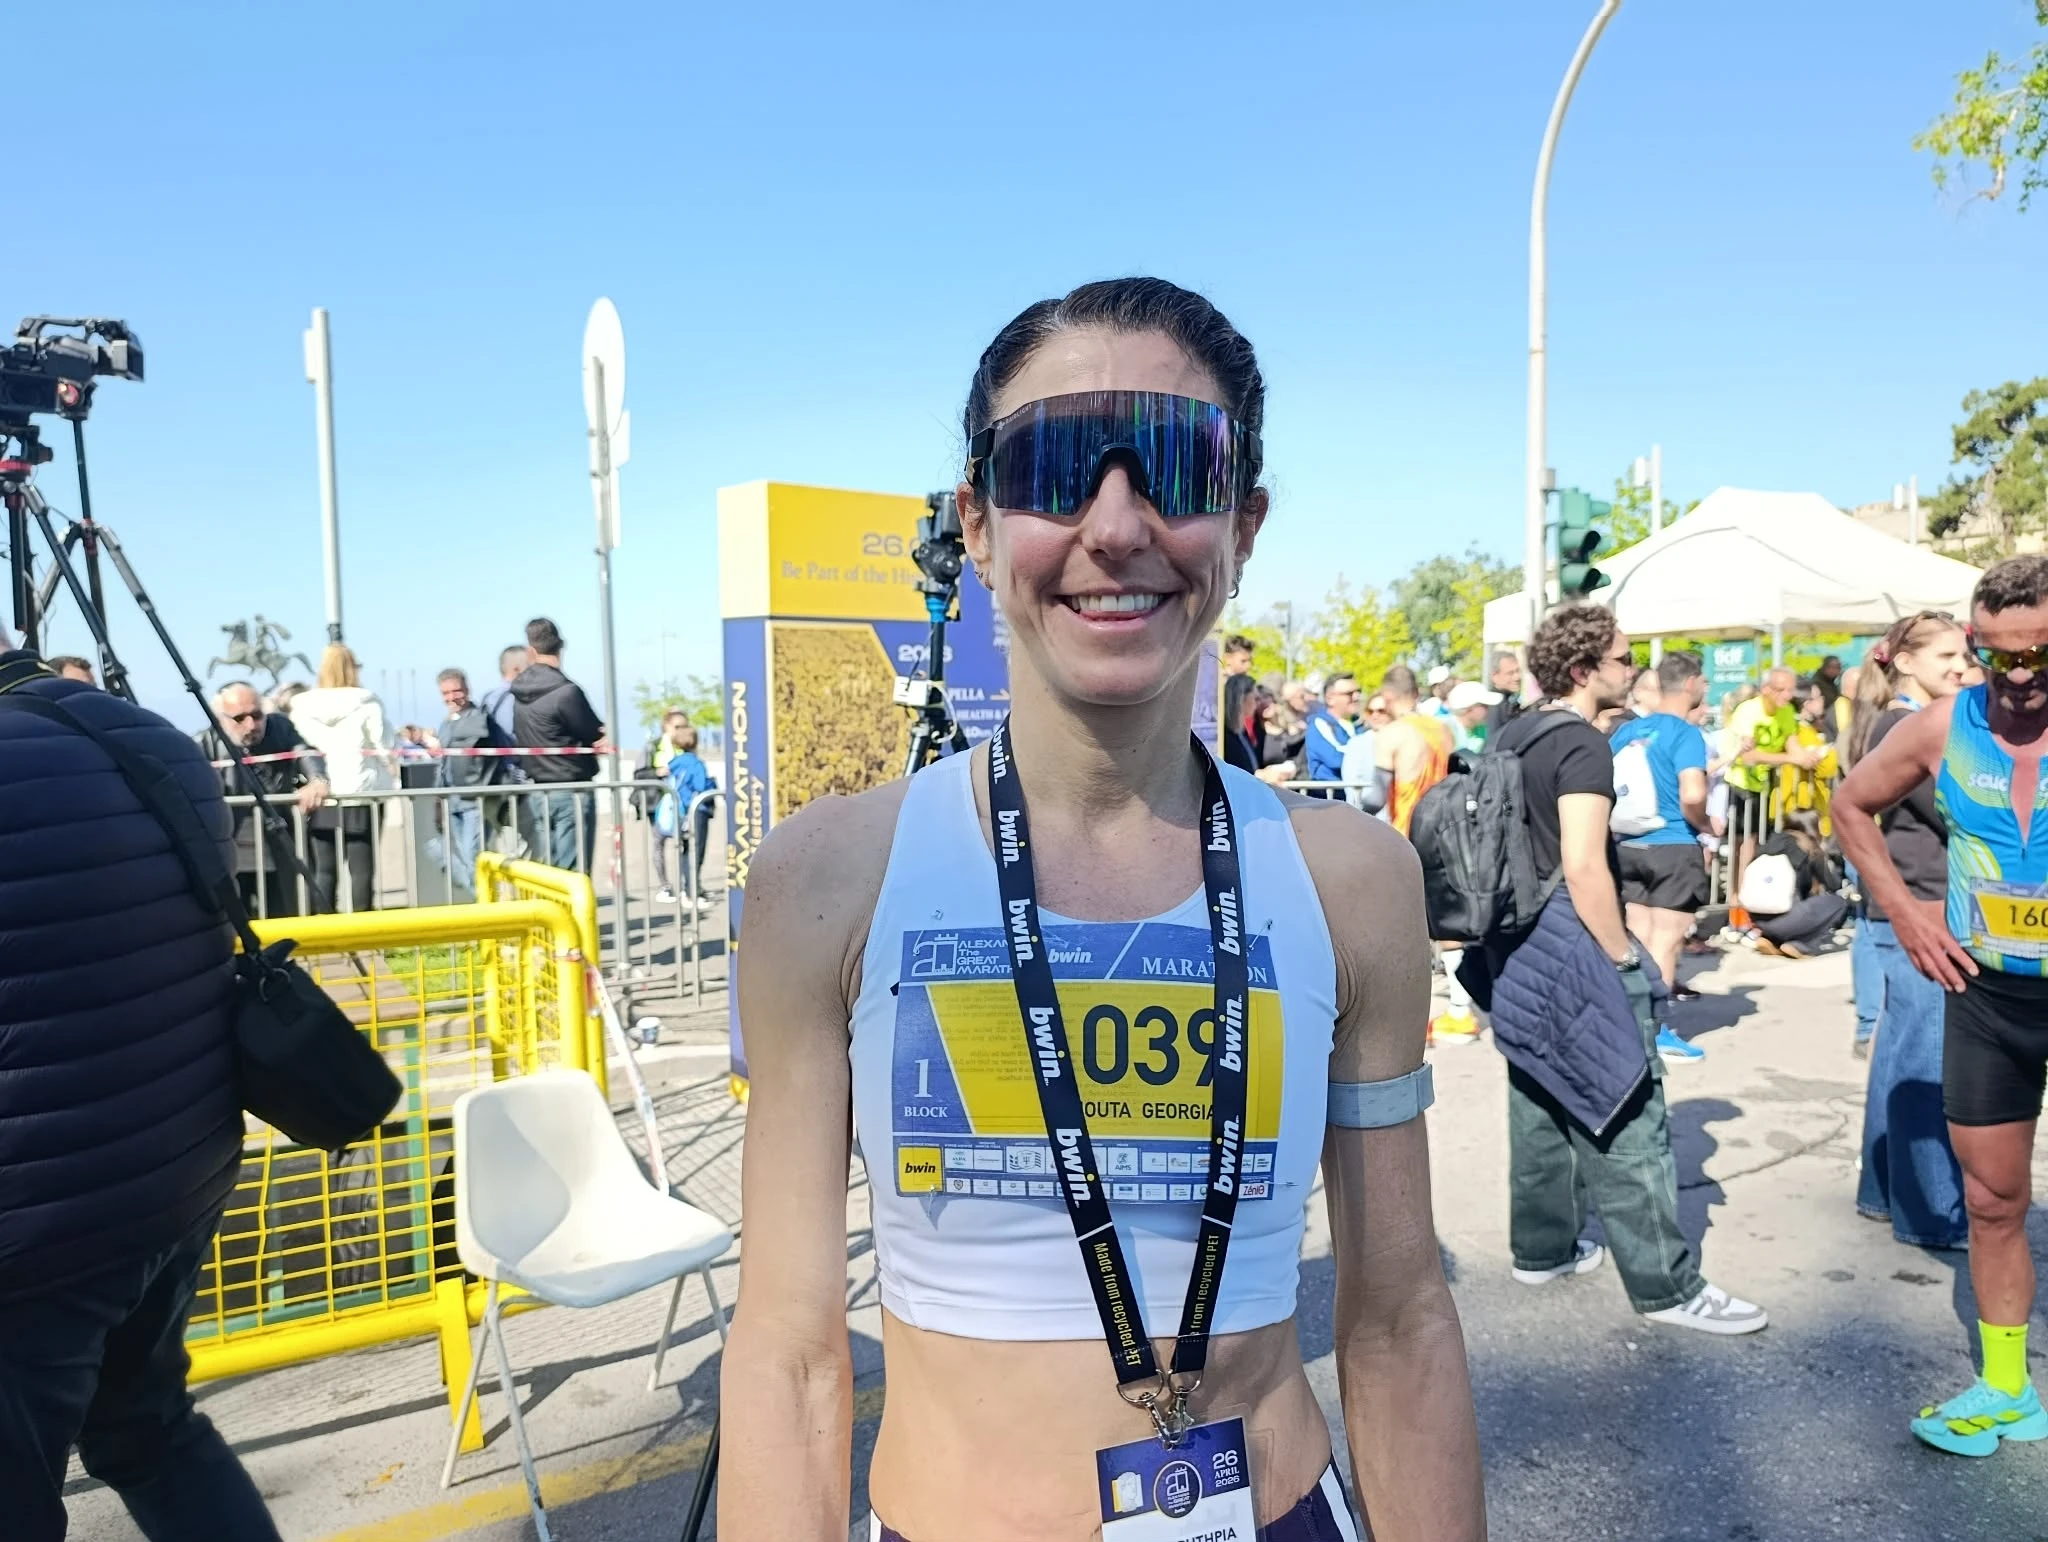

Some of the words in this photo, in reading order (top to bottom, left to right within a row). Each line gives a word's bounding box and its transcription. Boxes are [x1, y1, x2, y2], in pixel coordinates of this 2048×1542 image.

[782, 560, 801, 580] Be
[807, 561, 839, 581] Part
[844, 565, 859, 582] of
[864, 566, 887, 583] the
[992, 727, 1009, 778] bwin
[731, 681, 750, 889] MARATHON
[998, 809, 1025, 863] bwin
[1206, 799, 1230, 852] bwin
[1009, 898, 1039, 961] bwin
[1213, 892, 1240, 956] bwin
[957, 955, 999, 965] GREAT
[1048, 946, 1092, 964] bwin
[1029, 1006, 1065, 1079] bwin
[1218, 998, 1243, 1073] bwin
[914, 1058, 933, 1098] 1
[903, 1106, 948, 1118] BLOCK
[1082, 1102, 1132, 1119] OUTA
[905, 1162, 936, 1174] bwin
[1056, 1128, 1095, 1201] bwin
[1213, 1119, 1239, 1196] bwin
[1094, 1242, 1112, 1273] Made
[1103, 1273, 1121, 1300] from
[1190, 1304, 1205, 1331] from
[1198, 1254, 1216, 1303] recycled
[1207, 1234, 1220, 1252] PET
[1111, 1299, 1136, 1349] recycled
[1126, 1347, 1142, 1366] PET
[1212, 1449, 1238, 1470] 26
[1214, 1466, 1240, 1479] APRIL
[1215, 1475, 1240, 1488] 2026
